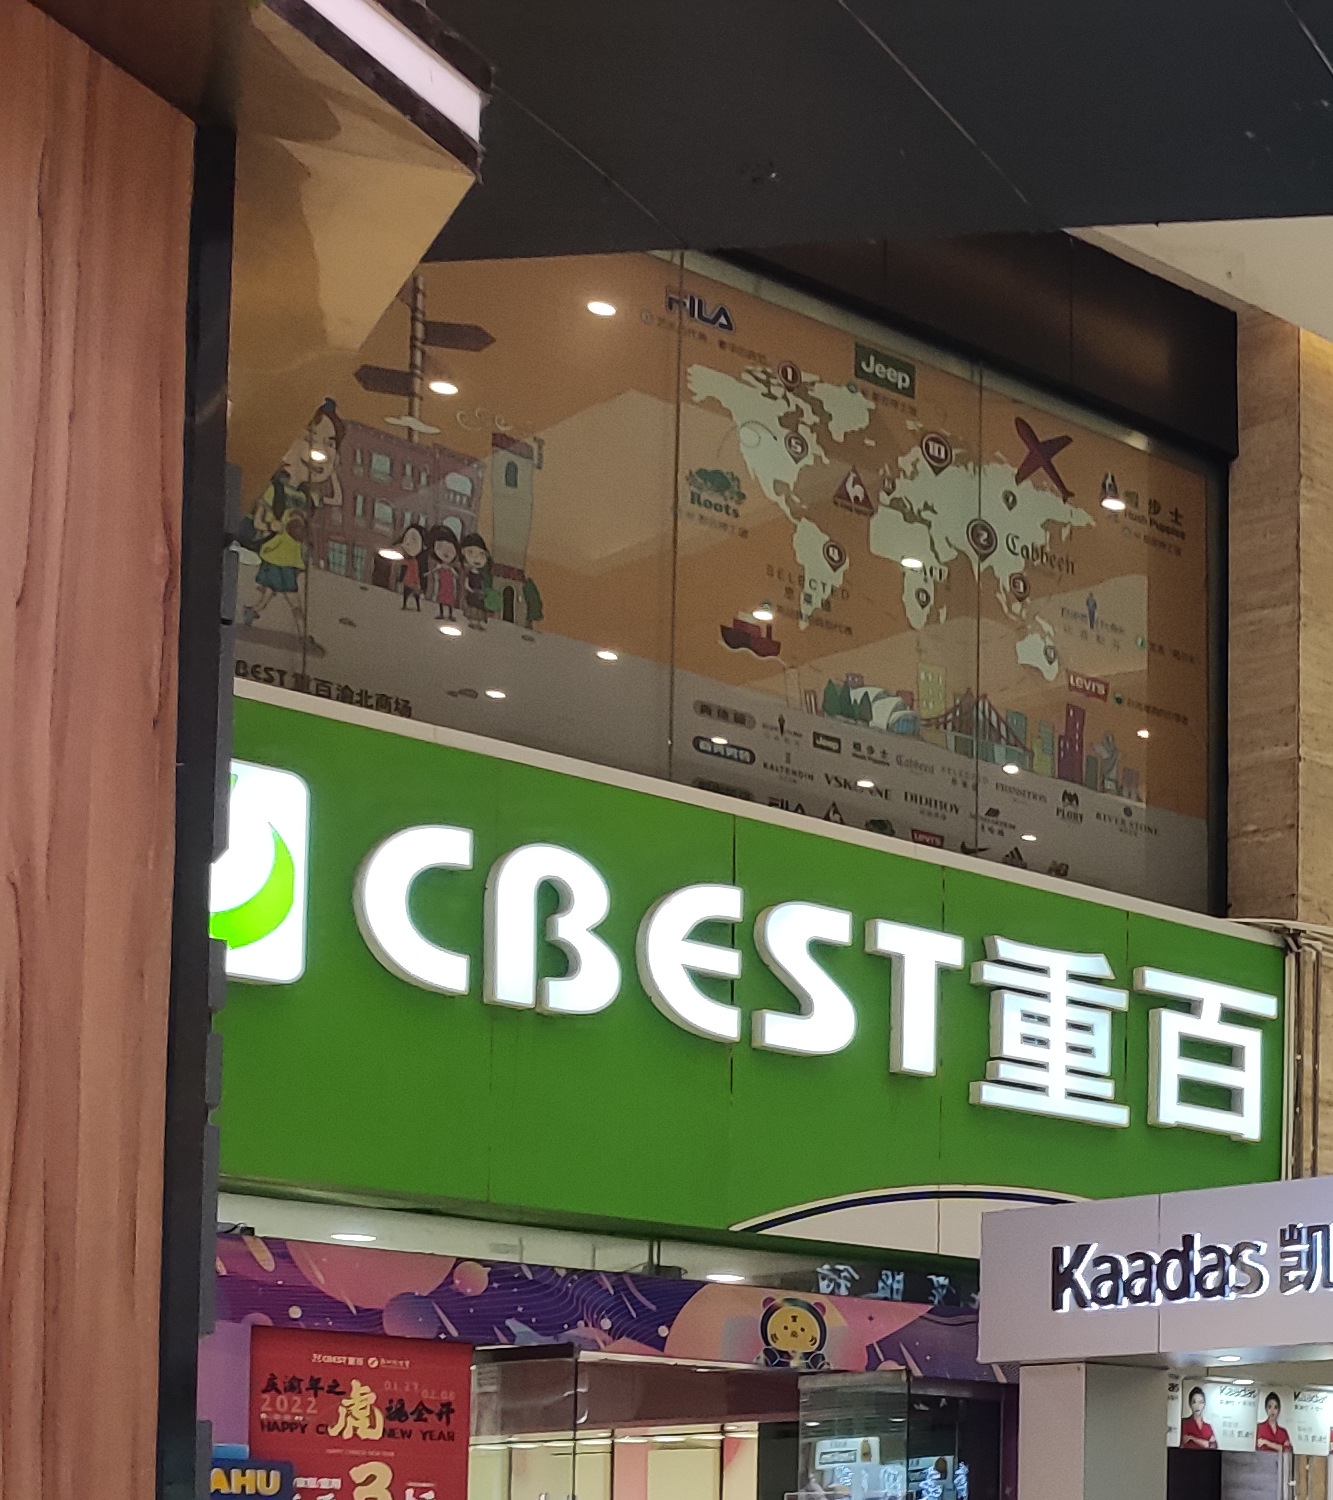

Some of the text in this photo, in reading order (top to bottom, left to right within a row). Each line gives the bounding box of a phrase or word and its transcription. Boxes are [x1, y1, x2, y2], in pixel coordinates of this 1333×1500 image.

[666, 286, 735, 333] FILA
[861, 355, 910, 389] Jeep
[690, 491, 740, 519] Roots
[352, 824, 1279, 1143] CBEST 重百
[1051, 1231, 1270, 1312] Kaadas
[261, 1395, 318, 1414] 2022
[327, 1379, 385, 1440] 虎
[260, 1420, 308, 1435] HAPPY
[419, 1429, 455, 1441] YEAR
